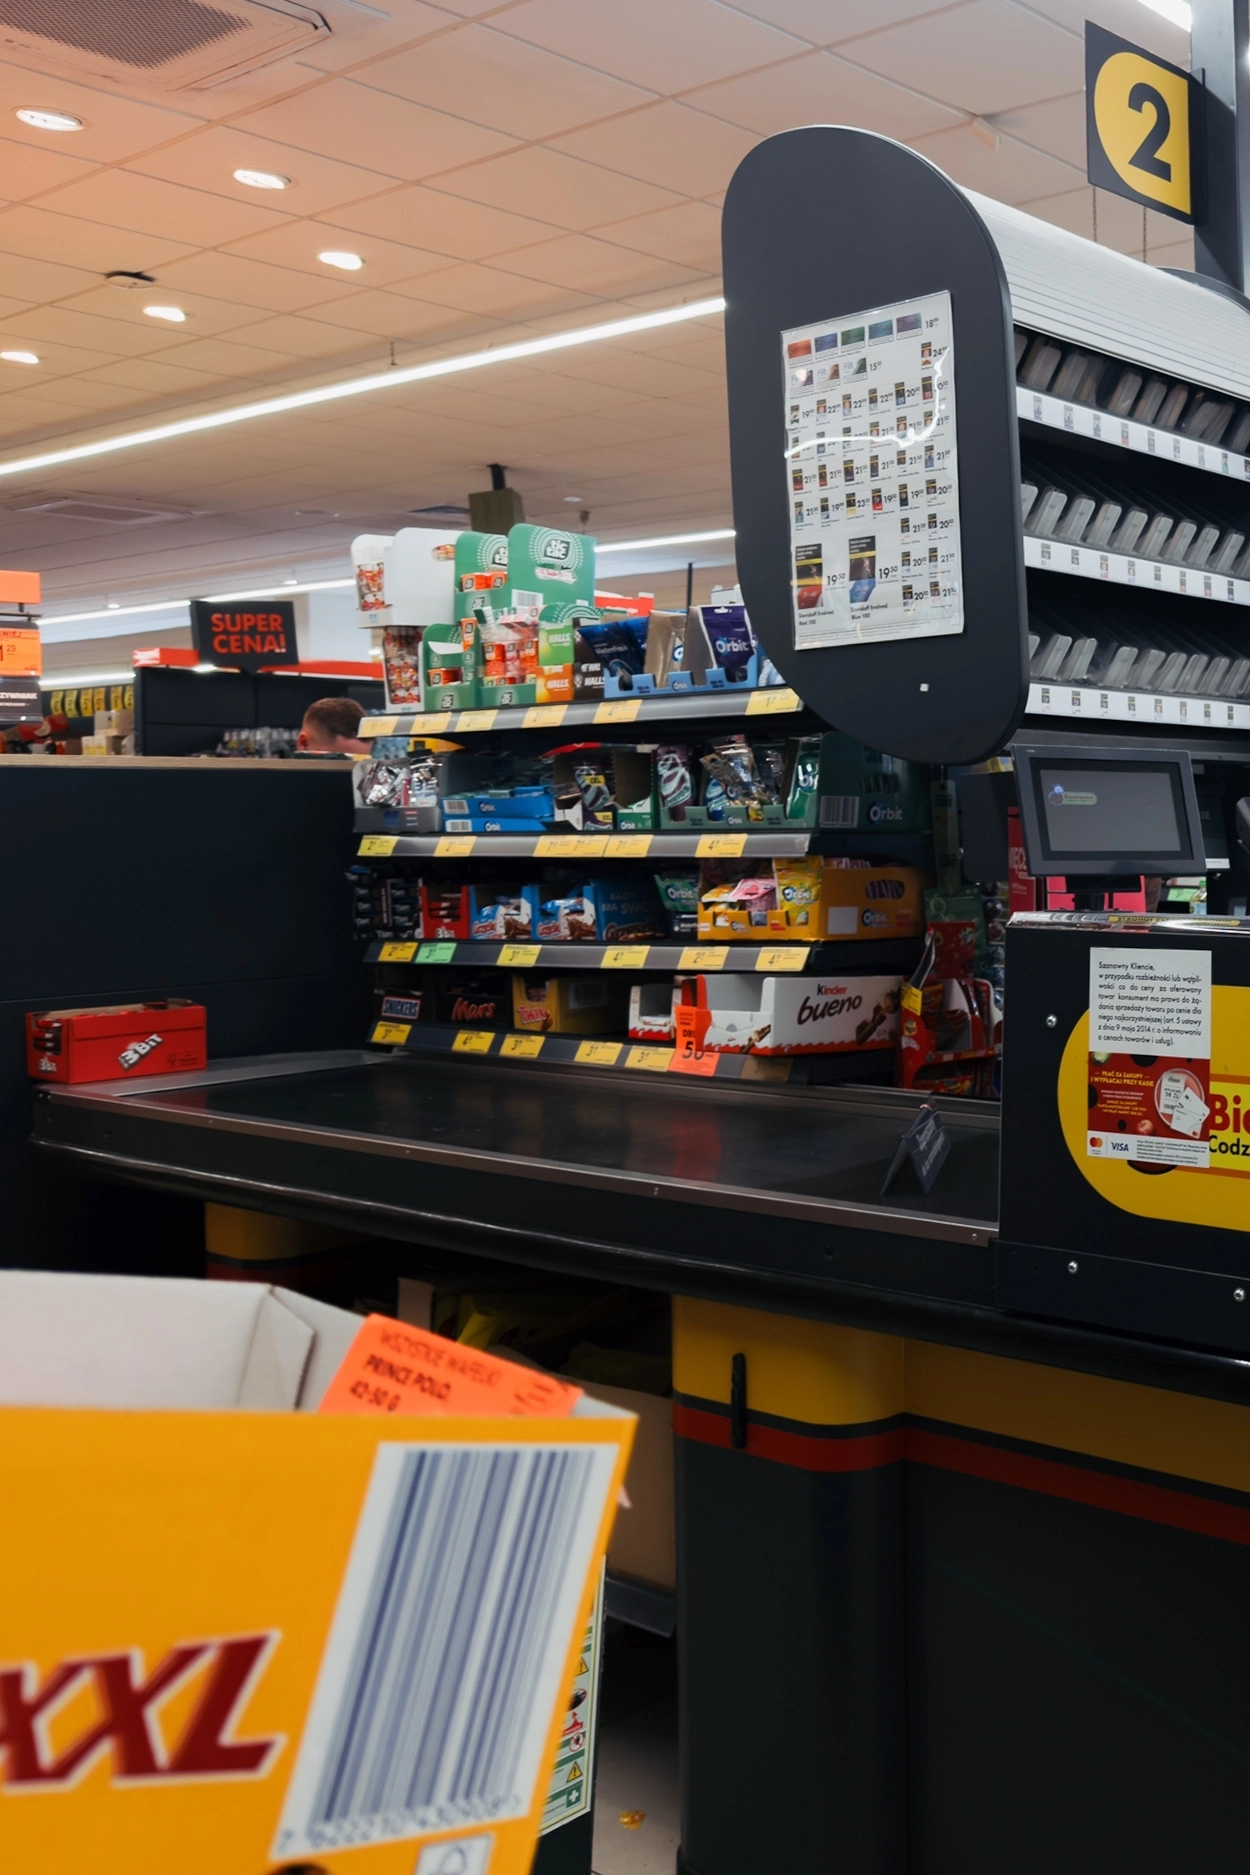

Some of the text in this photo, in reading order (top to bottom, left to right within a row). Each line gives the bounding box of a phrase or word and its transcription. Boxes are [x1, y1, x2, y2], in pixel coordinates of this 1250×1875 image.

[1128, 82, 1172, 183] 2
[550, 538, 568, 551] tic
[545, 547, 567, 560] tac
[210, 612, 283, 632] SUPER
[212, 633, 287, 654] CENA!
[548, 633, 571, 642] HALLS
[716, 638, 749, 654] Orbit
[868, 805, 903, 822] Orbit
[666, 886, 694, 900] Orbit
[862, 908, 887, 928] Orbit
[1098, 961, 1155, 972] Szanowny Kliencie,
[1104, 972, 1134, 981] przypadku
[1135, 973, 1171, 982] rozbieżności
[1182, 976, 1202, 984] wątpli-
[817, 983, 849, 996] kinder
[1141, 985, 1155, 993] ceny
[1169, 984, 1202, 995] oferowany
[1118, 993, 1149, 1002] konsument
[1160, 997, 1180, 1005] prawo
[1181, 996, 1190, 1004] do
[451, 998, 496, 1021] Mars
[797, 994, 863, 1025] bueno
[1098, 1003, 1114, 1011] dania
[1115, 1004, 1144, 1013] sprzedaży
[1145, 1005, 1165, 1013] towaru
[1192, 1006, 1202, 1014] dla
[1098, 1014, 1113, 1022] niego
[1114, 1015, 1163, 1025] najkorzystniejszej
[1181, 1018, 1202, 1027] ustawy
[1121, 1025, 1135, 1033] maja
[1136, 1025, 1151, 1033] 2014
[1162, 1027, 1202, 1036] informowaniu
[1103, 1034, 1124, 1042] cenach
[1125, 1035, 1150, 1043] towarów
[1155, 1036, 1175, 1047] usług).
[1111, 1141, 1129, 1152] VISA
[379, 1327, 447, 1369] WSZYSTKIE
[364, 1353, 452, 1401] PRINCE POLO
[0, 1625, 287, 1795] XXL
